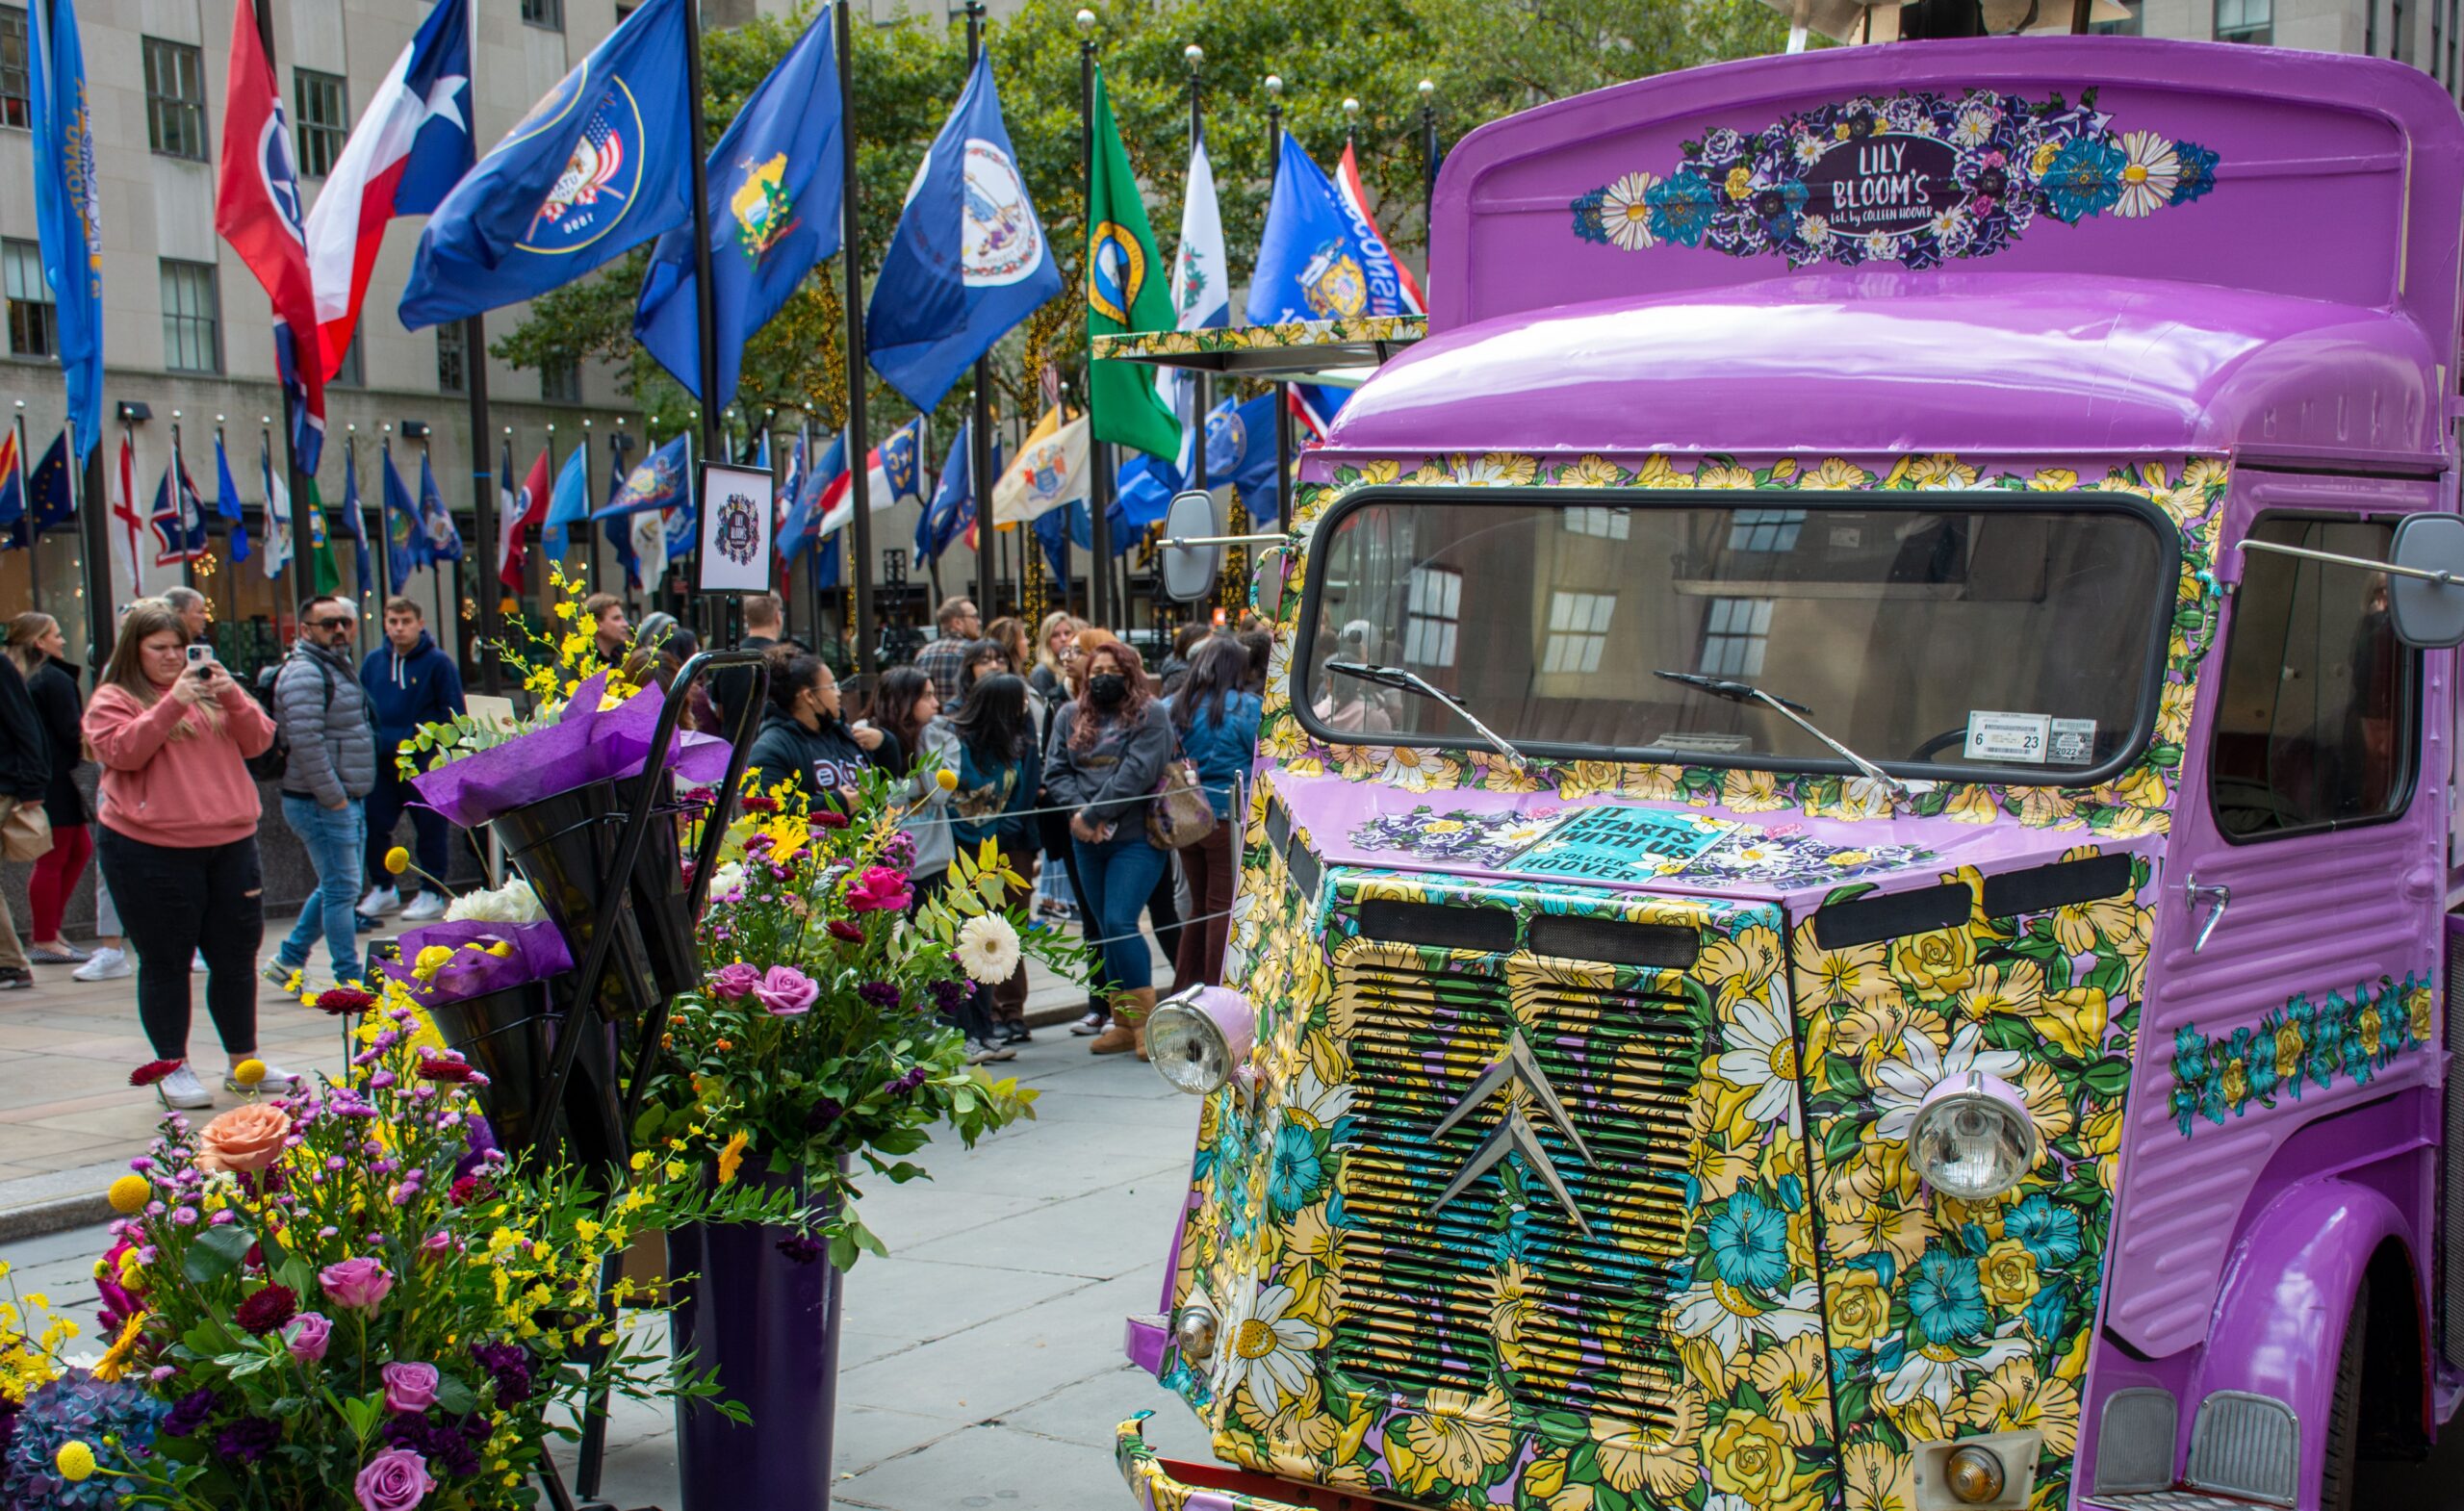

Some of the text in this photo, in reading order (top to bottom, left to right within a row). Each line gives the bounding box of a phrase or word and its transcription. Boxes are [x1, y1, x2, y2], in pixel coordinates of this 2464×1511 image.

[1859, 141, 1906, 176] LILY
[1833, 168, 1930, 210] BLOOM'S
[1849, 210, 1861, 227] by
[1862, 208, 1897, 222] COLLEEN
[1899, 205, 1933, 219] HOOVER
[1975, 732, 1984, 746] 6
[2023, 735, 2040, 749] 23
[2056, 747, 2077, 756] 2022
[1595, 807, 1632, 818] IT
[1571, 818, 1702, 845] STARTS
[1556, 831, 1697, 860] WITH US
[1521, 858, 1638, 882] HOOVER
[1553, 852, 1630, 867] COLLEEN
